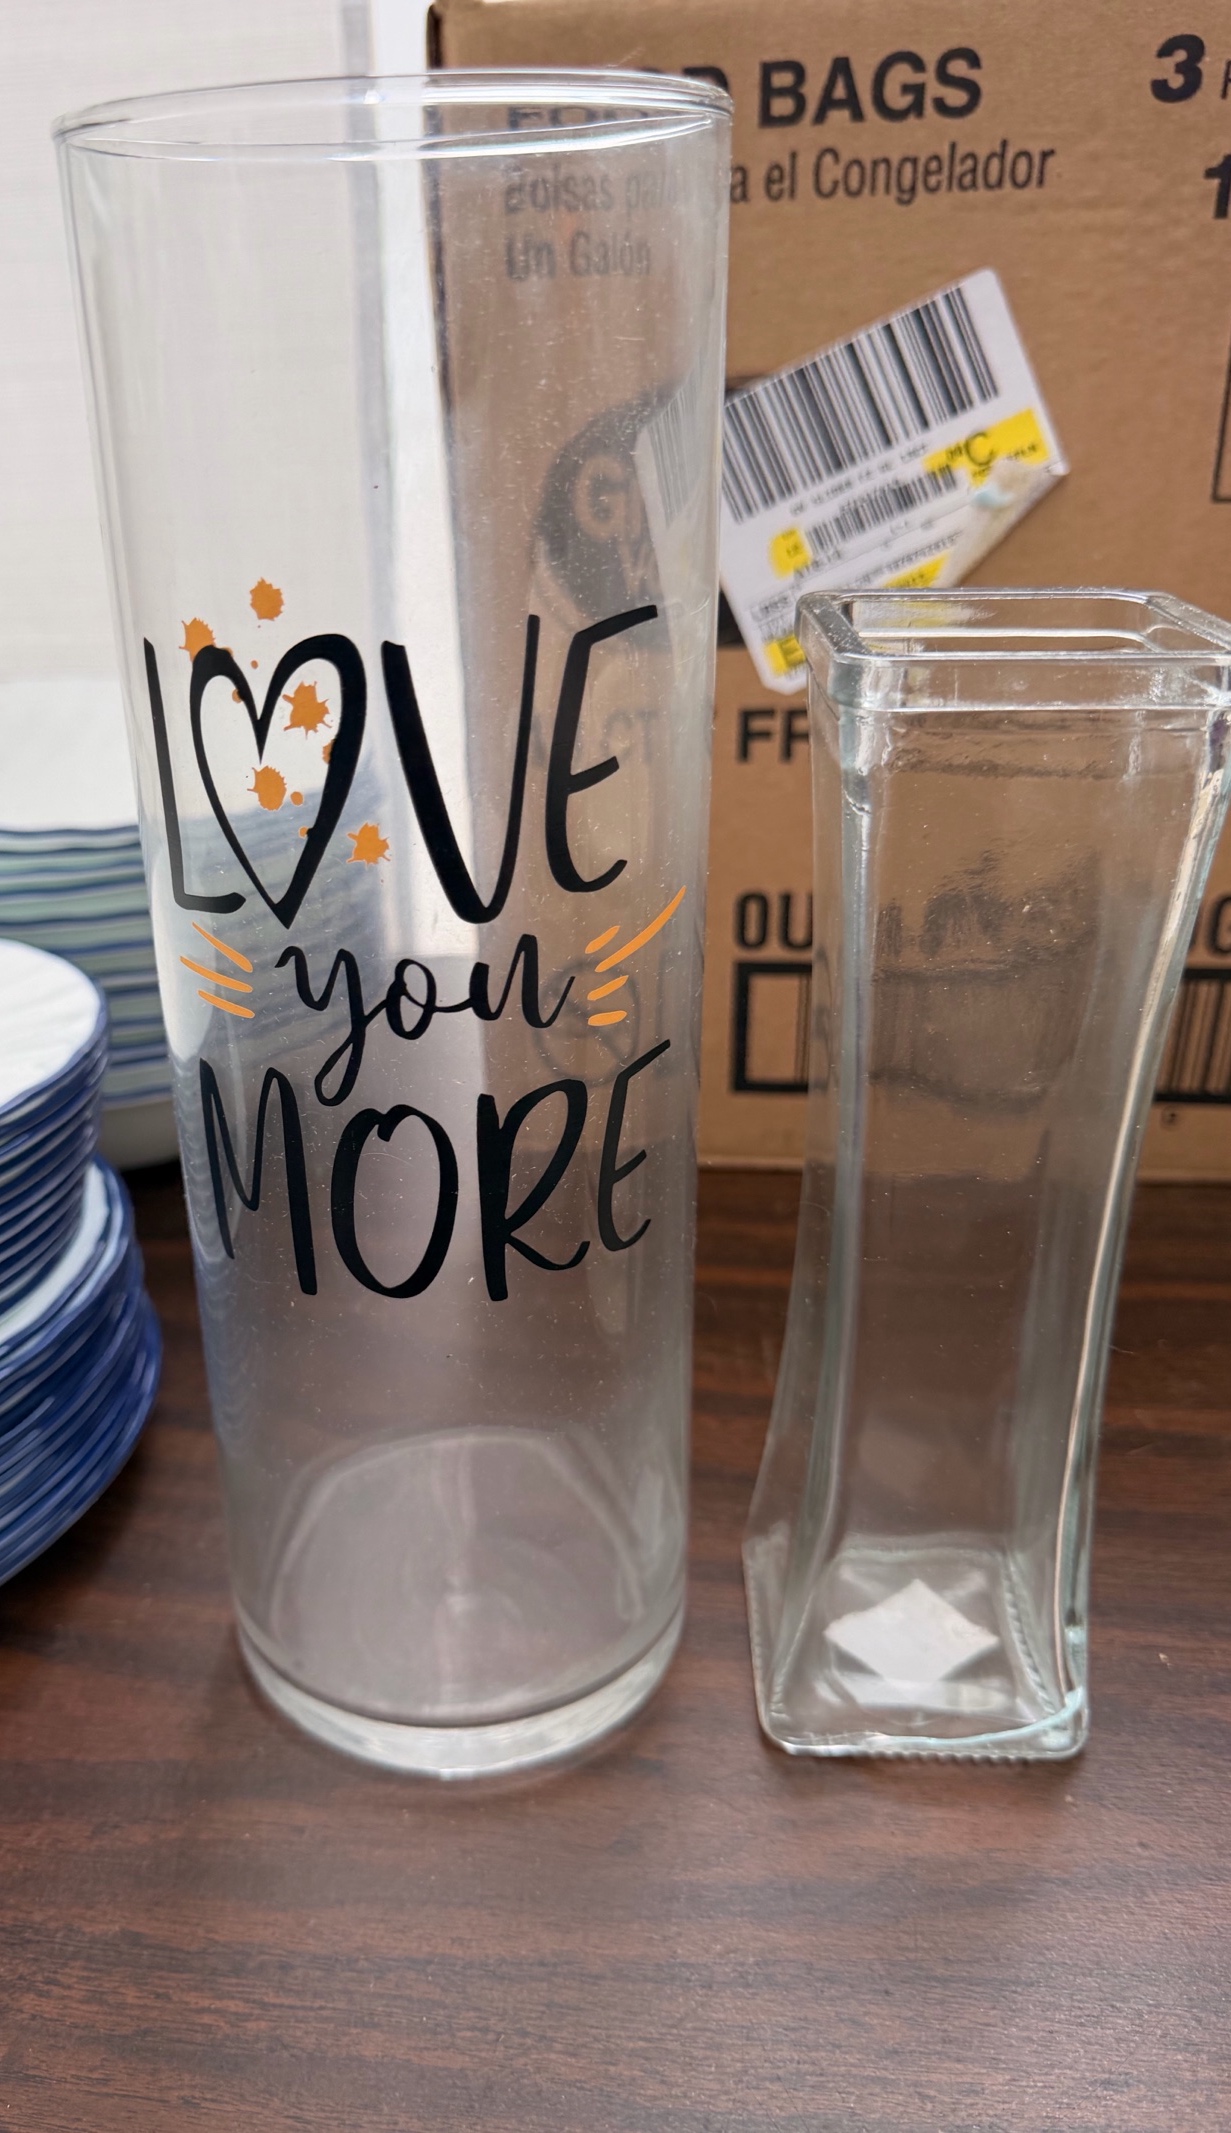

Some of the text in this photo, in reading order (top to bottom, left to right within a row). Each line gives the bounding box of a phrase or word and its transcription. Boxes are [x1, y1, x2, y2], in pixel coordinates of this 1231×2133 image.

[757, 47, 983, 128] BAGS
[1151, 34, 1206, 104] 3
[765, 150, 798, 199] el
[812, 139, 1057, 206] Congelador
[143, 604, 659, 930] LOVE
[274, 933, 576, 1107] you
[200, 1038, 671, 1302] MORE
